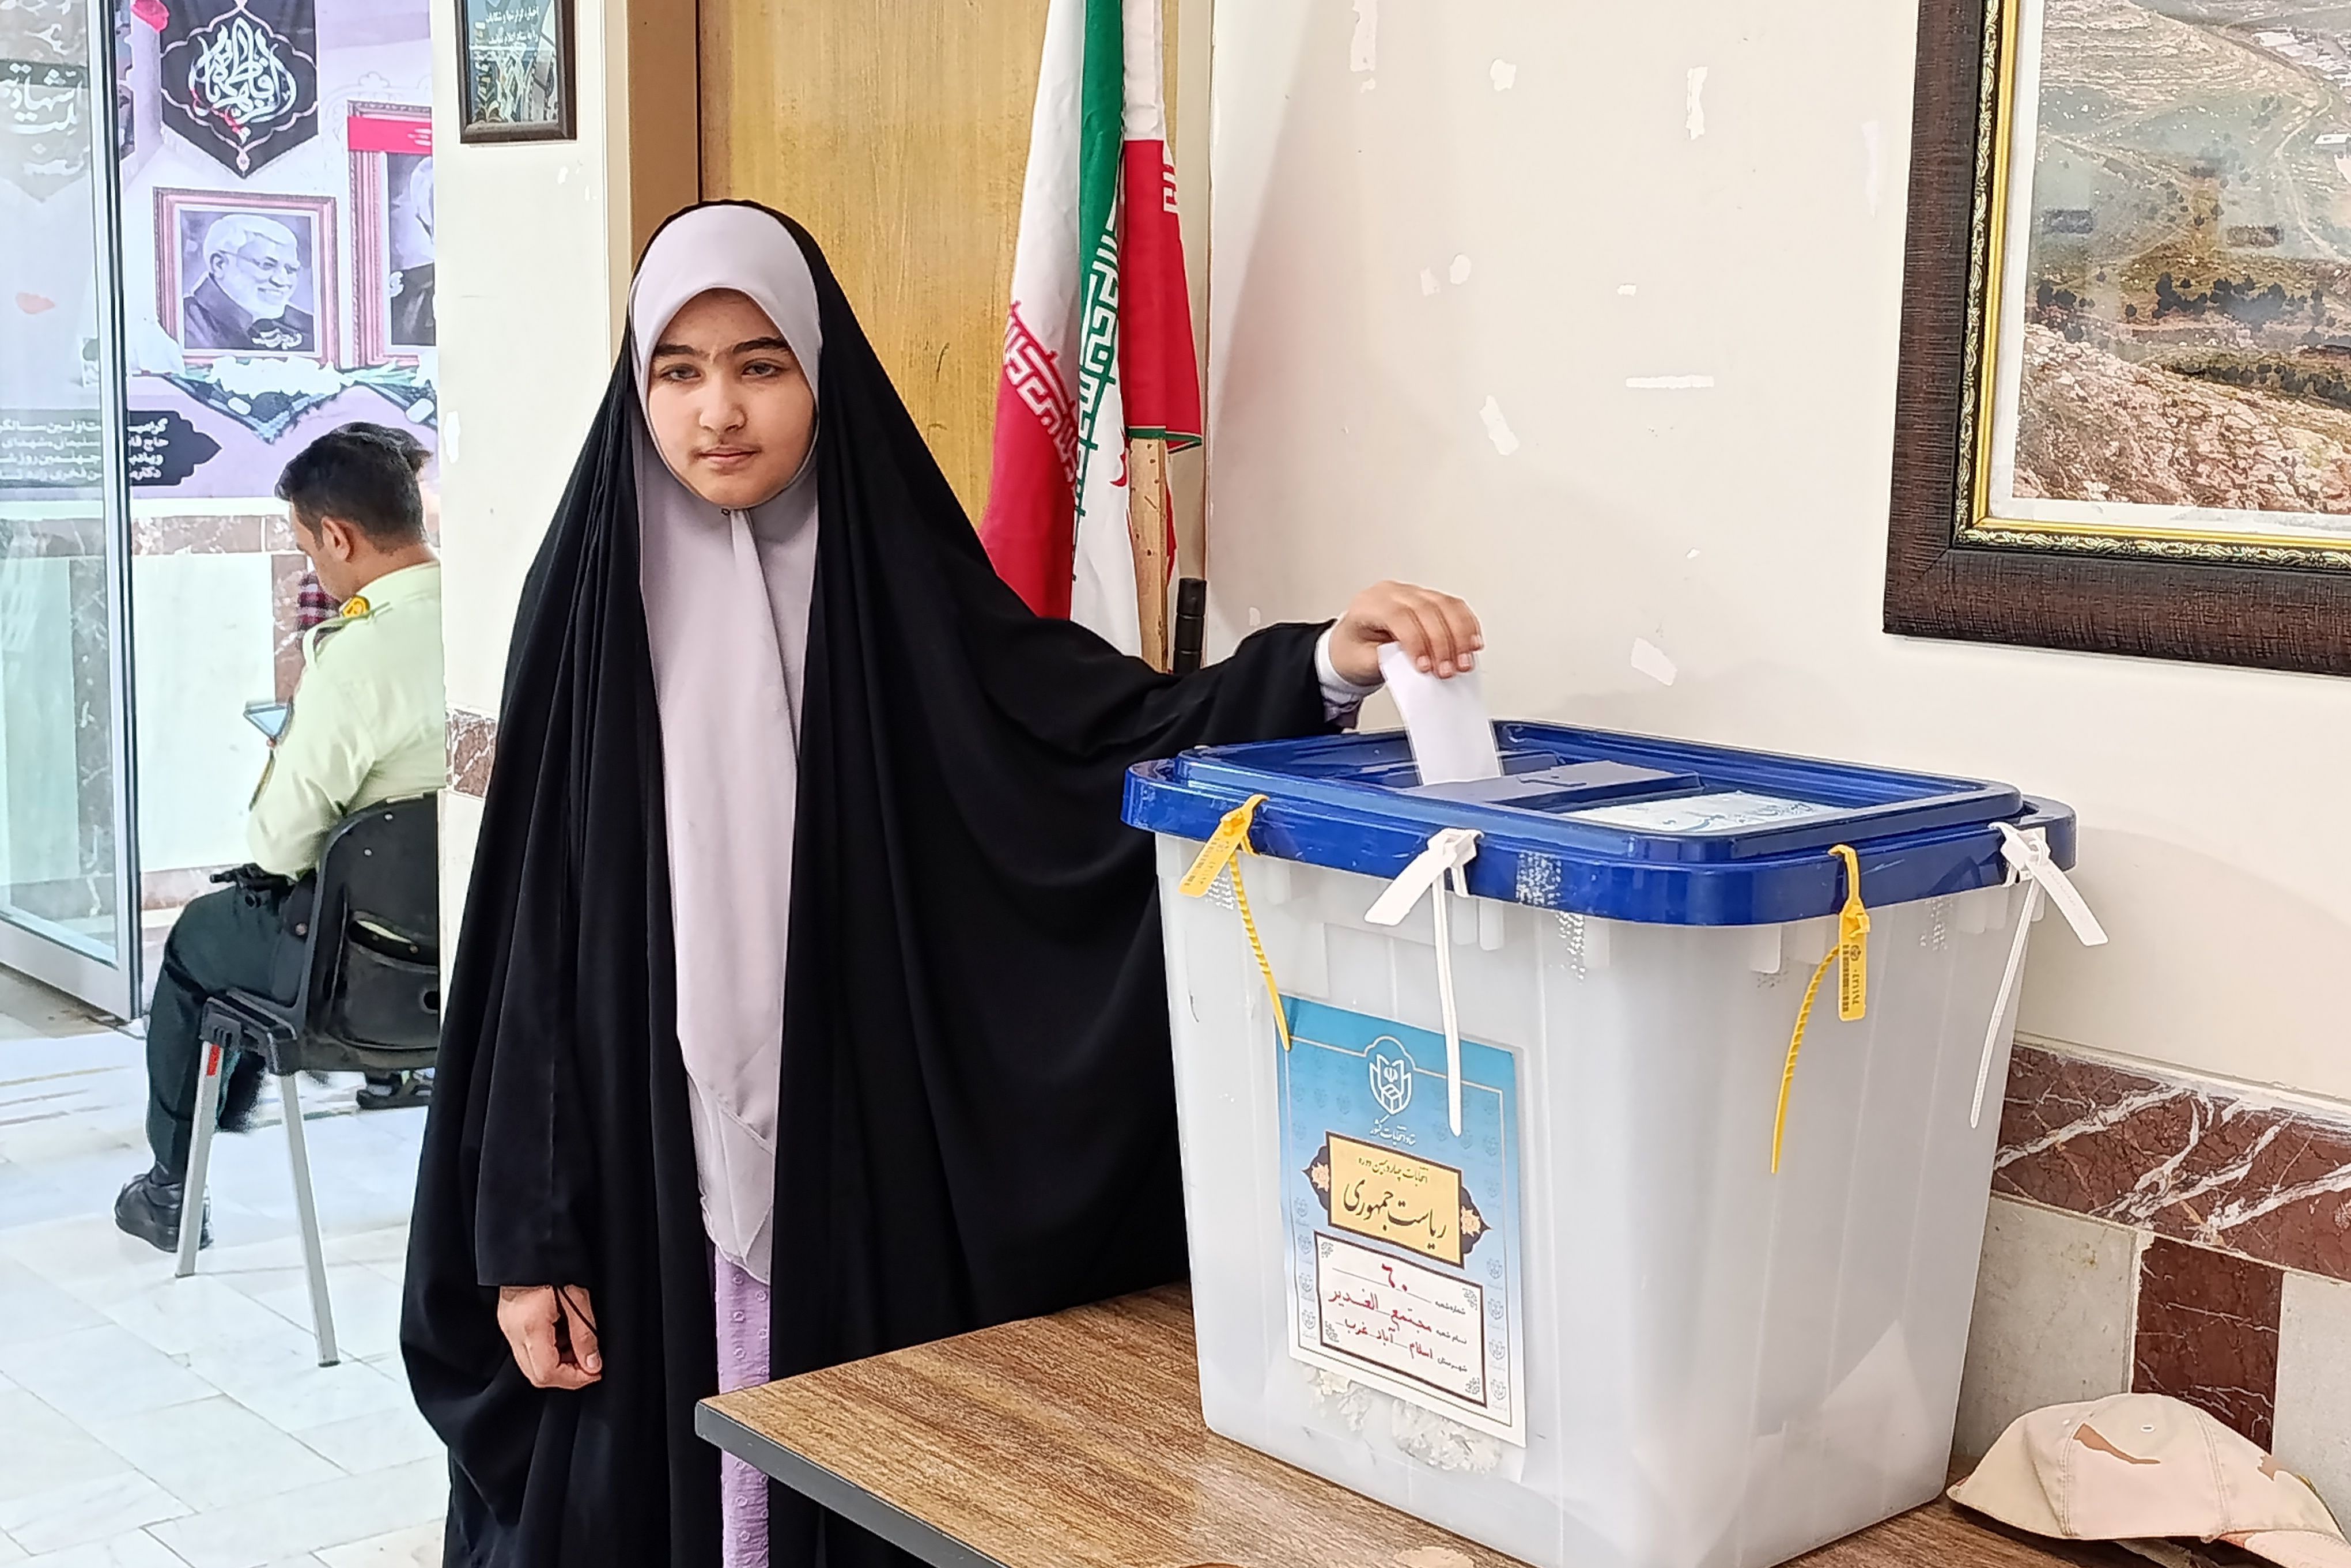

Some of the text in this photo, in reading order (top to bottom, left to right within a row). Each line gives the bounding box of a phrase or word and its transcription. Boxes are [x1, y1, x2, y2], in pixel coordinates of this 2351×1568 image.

[1343, 1179, 1447, 1250] ریاست جمهوری
[1344, 1318, 1368, 1335] غرب
[1390, 1308, 1432, 1333] مجتمع
[1376, 1327, 1396, 1346] آباد
[1409, 1341, 1434, 1359] اسلام
